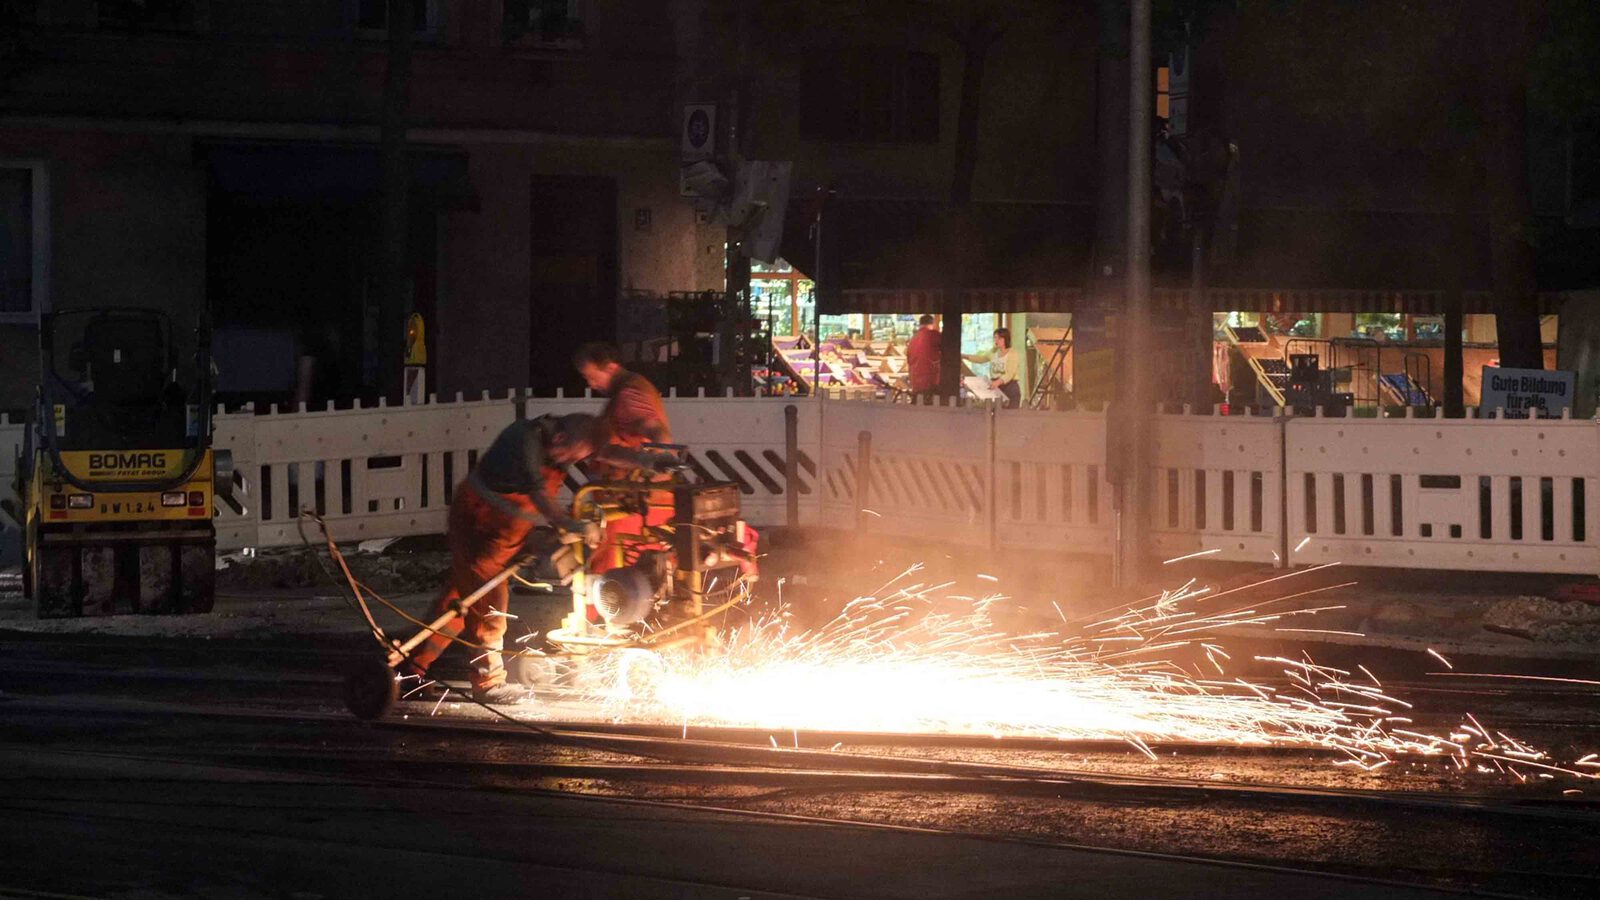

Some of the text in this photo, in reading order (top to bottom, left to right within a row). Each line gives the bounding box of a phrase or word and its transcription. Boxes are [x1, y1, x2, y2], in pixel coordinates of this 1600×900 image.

[1492, 375, 1567, 396] Gute Bildung
[1507, 392, 1523, 409] für
[89, 454, 165, 468] BOMAG
